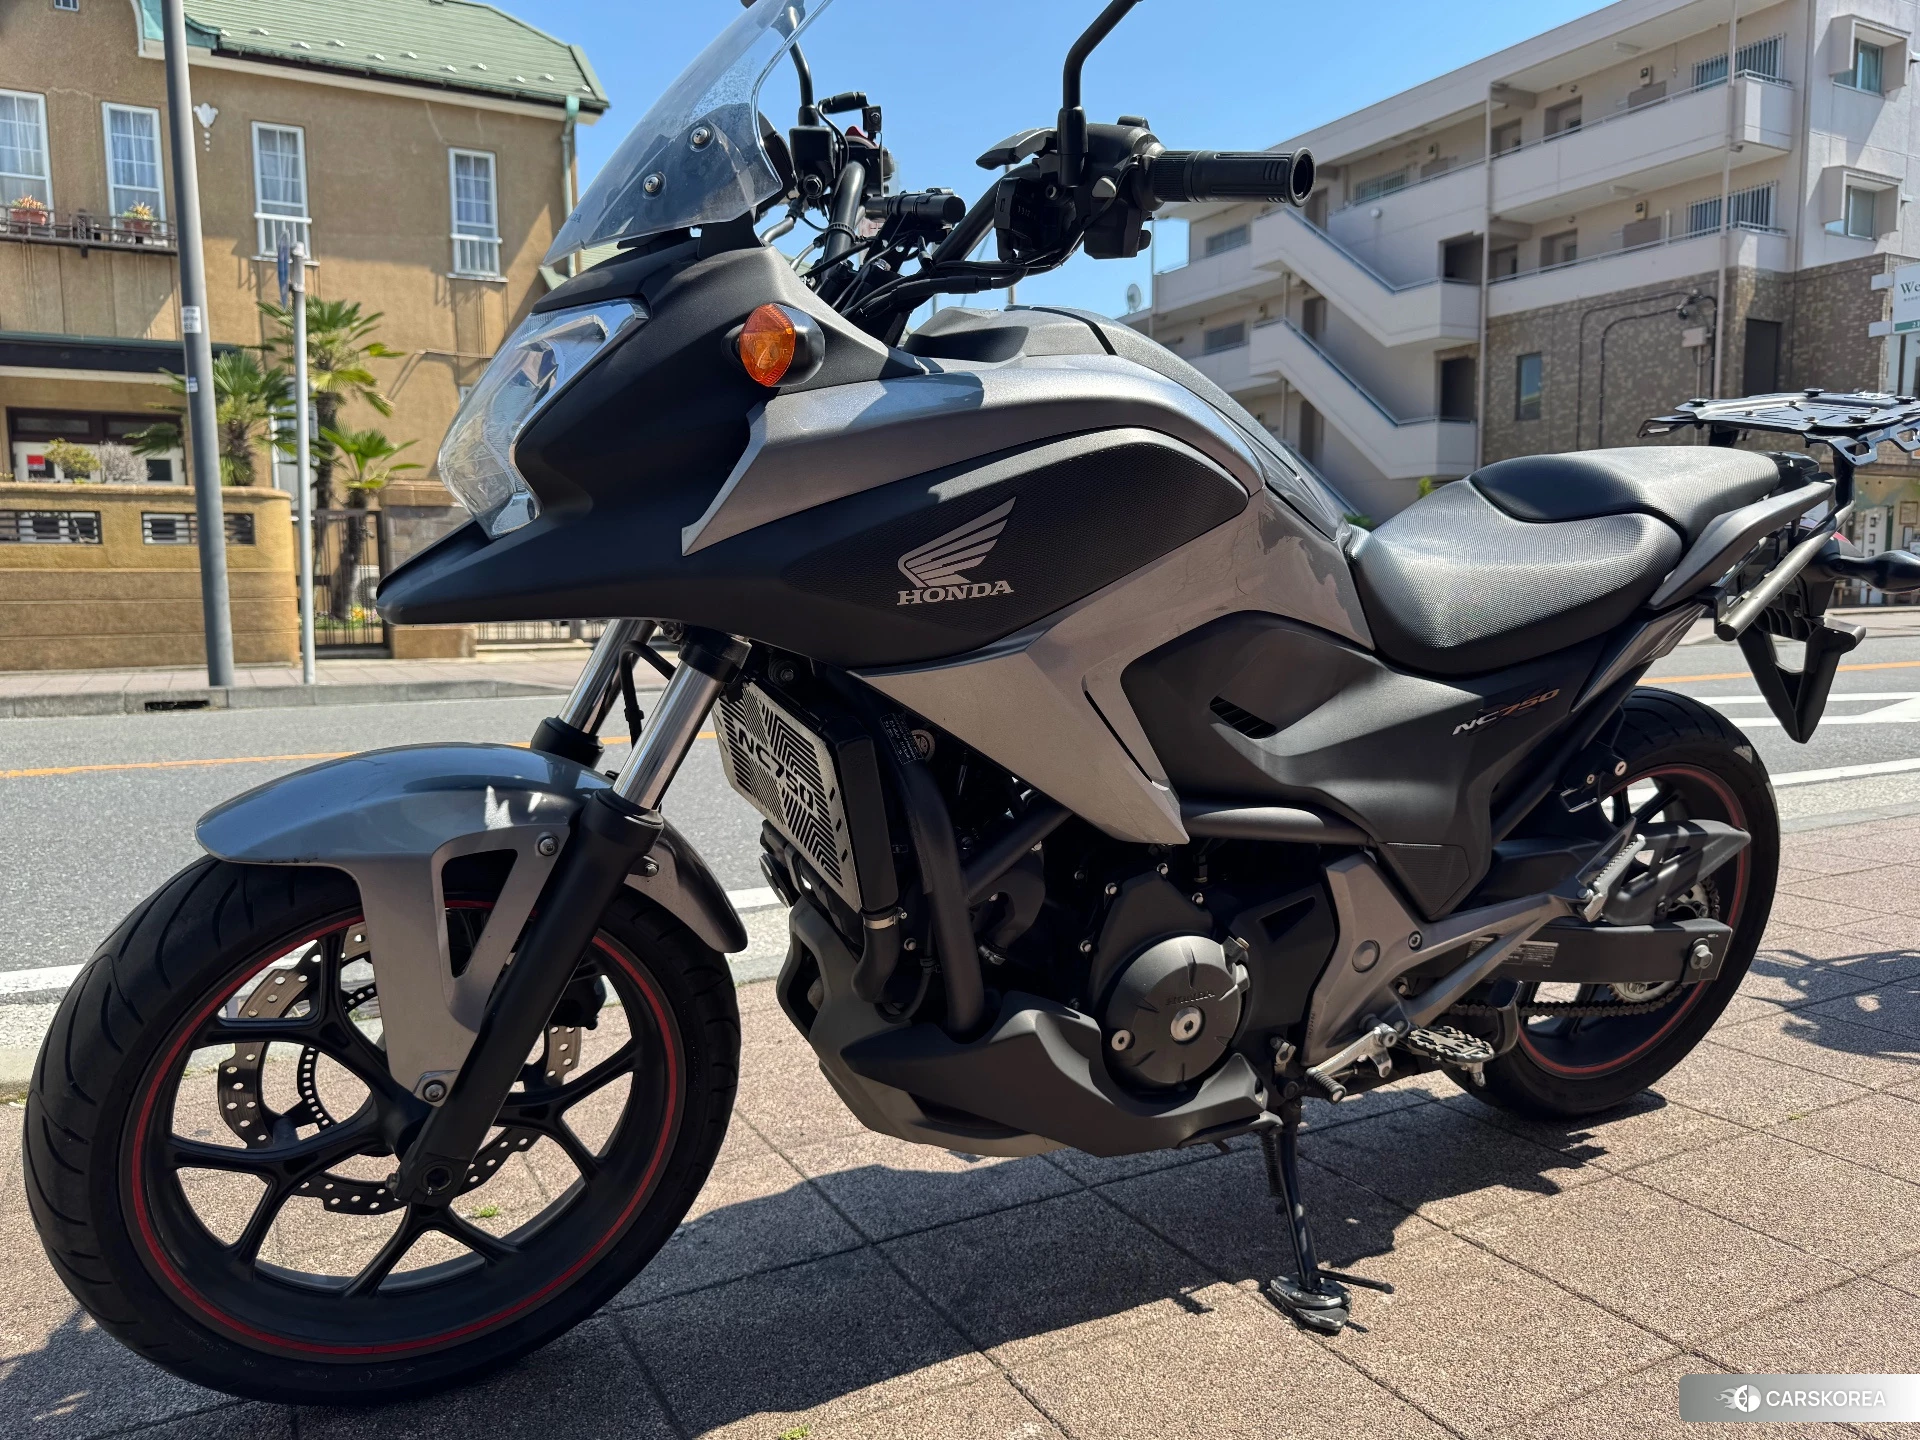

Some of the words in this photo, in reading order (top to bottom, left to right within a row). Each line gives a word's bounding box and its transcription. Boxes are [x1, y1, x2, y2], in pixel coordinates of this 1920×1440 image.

[897, 580, 1014, 605] HONDA
[1452, 689, 1560, 735] NC750
[737, 727, 815, 811] NC750
